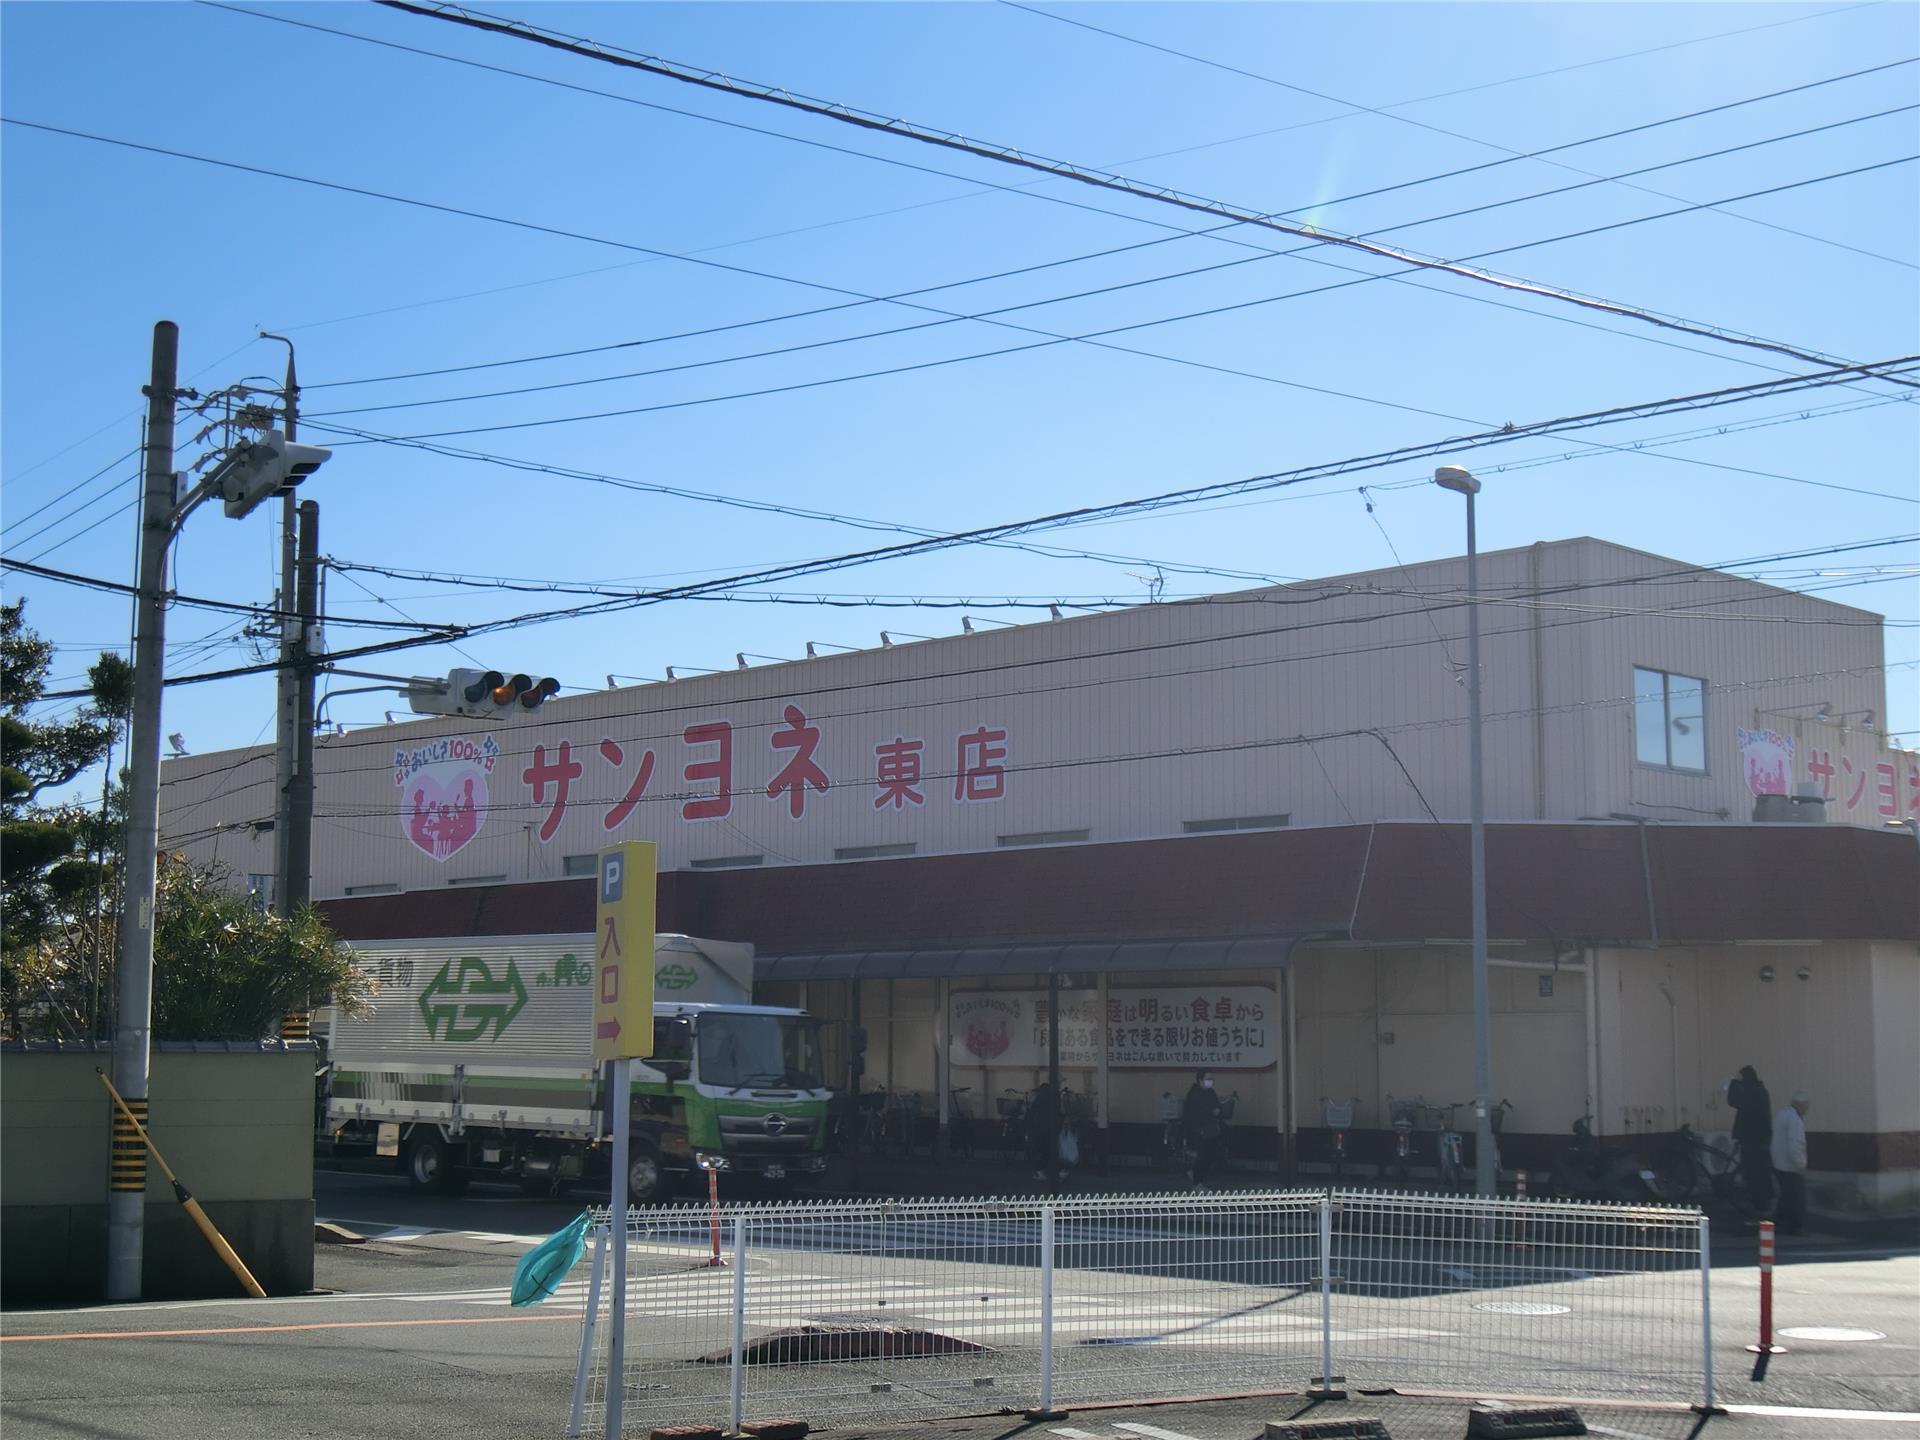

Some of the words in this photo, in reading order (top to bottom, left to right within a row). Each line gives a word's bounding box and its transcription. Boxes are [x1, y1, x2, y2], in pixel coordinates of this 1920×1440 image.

[523, 704, 830, 841] サンヨネ
[875, 726, 1007, 809] 東店
[605, 861, 620, 895] P
[600, 916, 621, 1005] 入口
